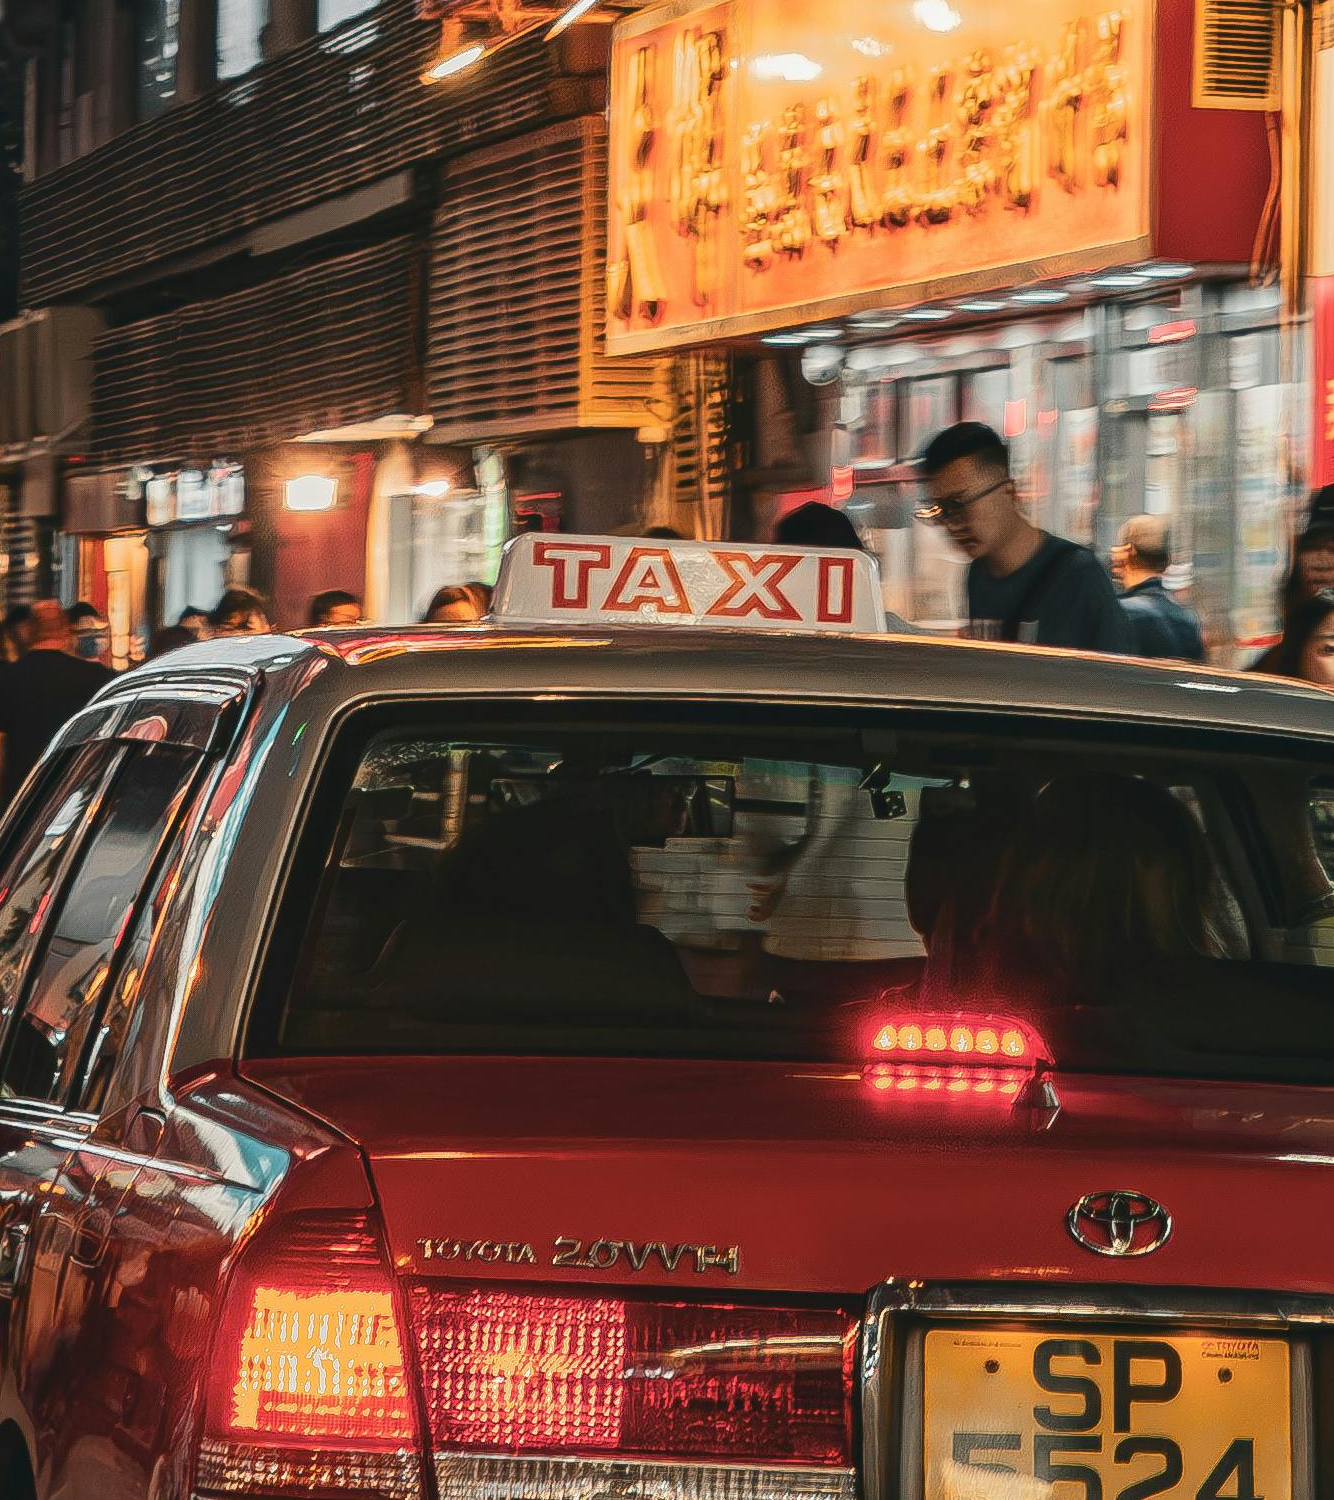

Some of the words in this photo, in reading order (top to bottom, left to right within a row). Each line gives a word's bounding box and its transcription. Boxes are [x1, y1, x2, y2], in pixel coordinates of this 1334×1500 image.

[532, 541, 855, 624] TAXI
[416, 1237, 539, 1264] TOYOTA
[1032, 1337, 1184, 1434] SP
